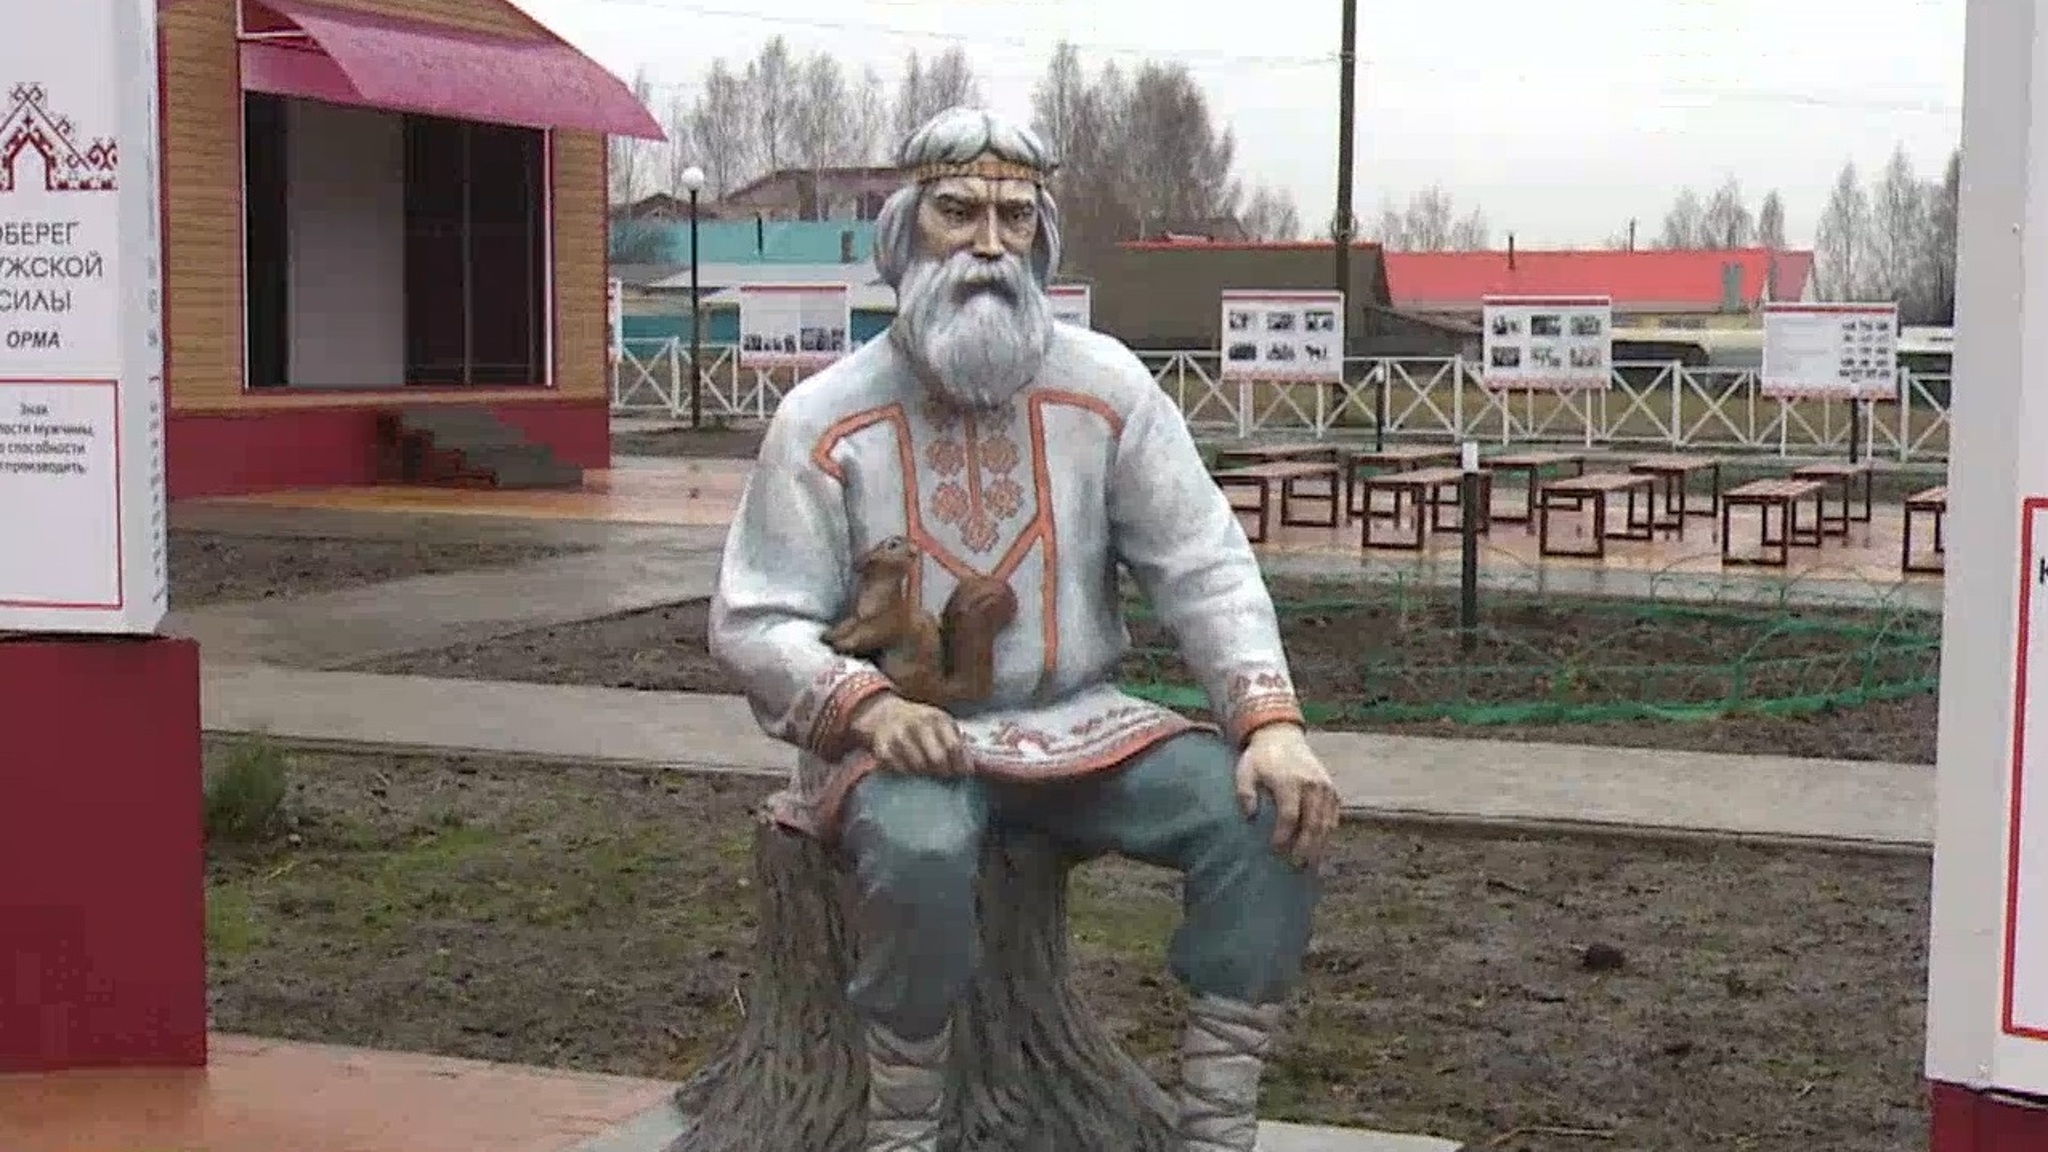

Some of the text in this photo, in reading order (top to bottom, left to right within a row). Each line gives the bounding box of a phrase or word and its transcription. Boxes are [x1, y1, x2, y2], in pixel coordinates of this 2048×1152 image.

[0, 221, 80, 245] БЕРЕГ
[0, 288, 71, 312] СИЛЫ
[6, 330, 60, 348] ОРМА
